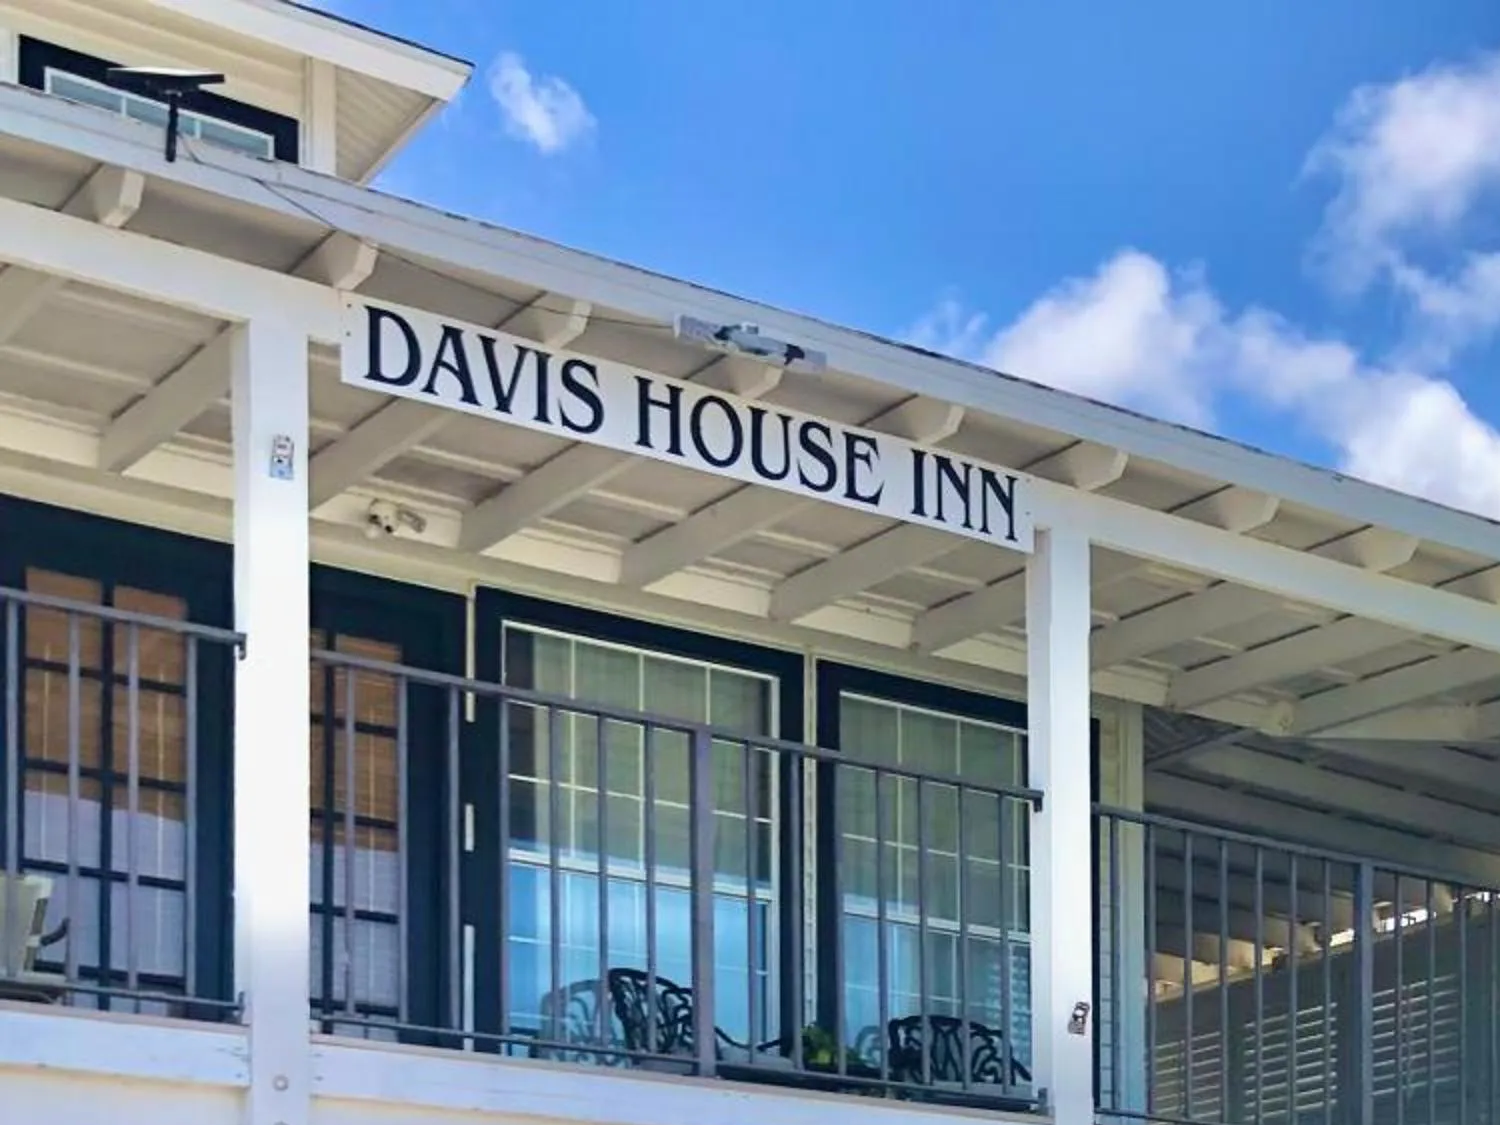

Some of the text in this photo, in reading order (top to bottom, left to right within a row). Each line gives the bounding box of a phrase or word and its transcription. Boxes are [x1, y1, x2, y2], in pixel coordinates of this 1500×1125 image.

[364, 305, 1019, 542] DAVIS HOUSE INN
